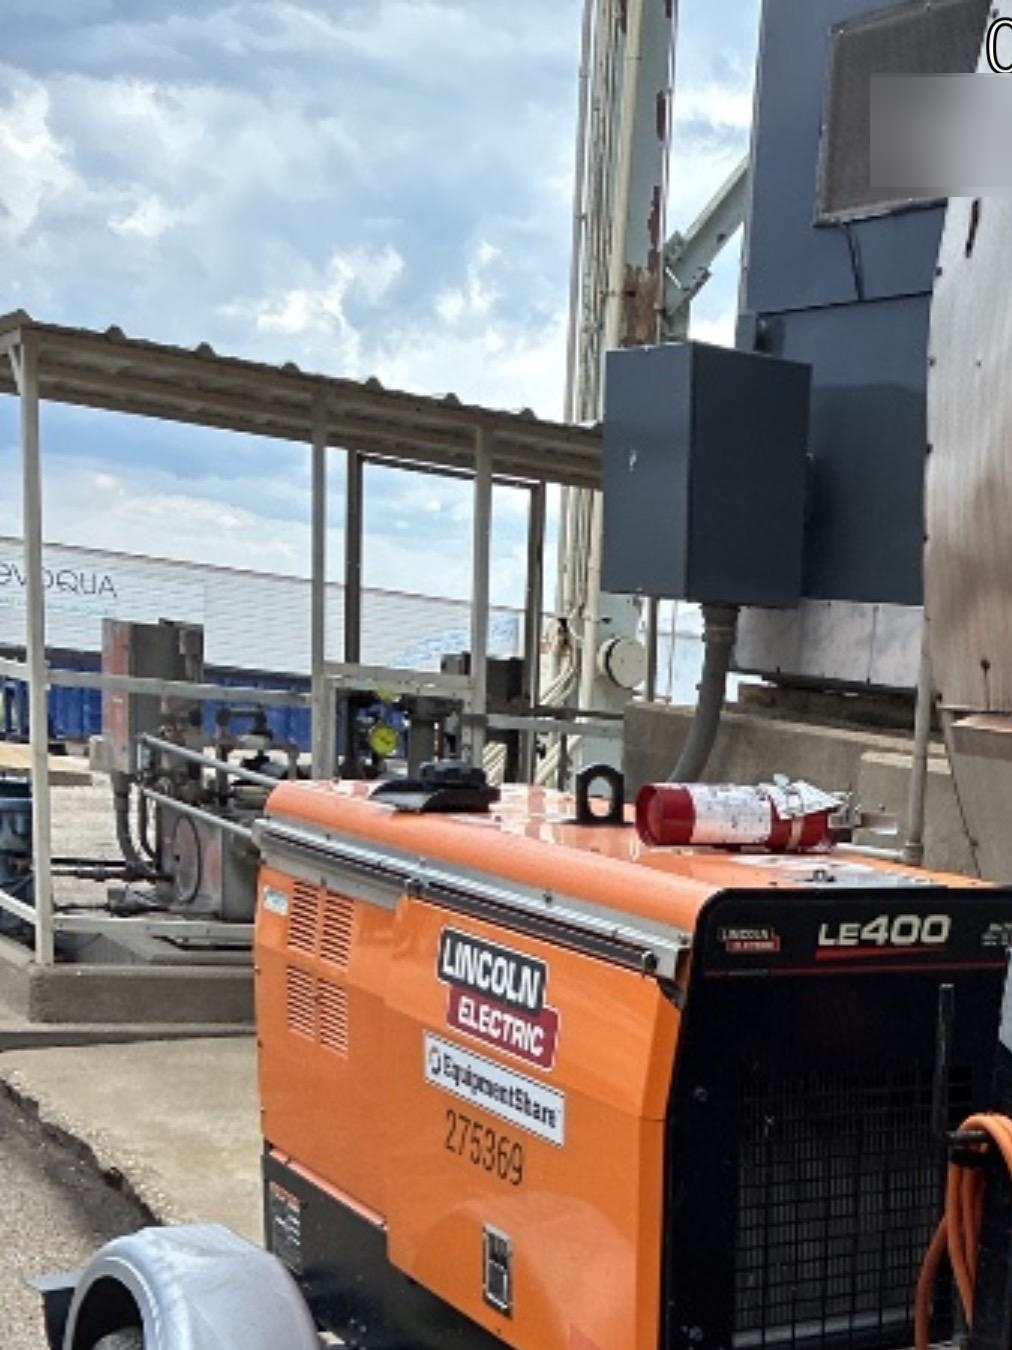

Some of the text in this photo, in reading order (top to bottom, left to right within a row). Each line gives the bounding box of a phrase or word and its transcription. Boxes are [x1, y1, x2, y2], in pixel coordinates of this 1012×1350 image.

[817, 913, 952, 947] LE400
[442, 937, 541, 1010] LINCOLN
[457, 995, 545, 1058] ELECTRIC
[443, 1051, 557, 1130] EquipmentShare
[444, 1108, 524, 1187] 275369
